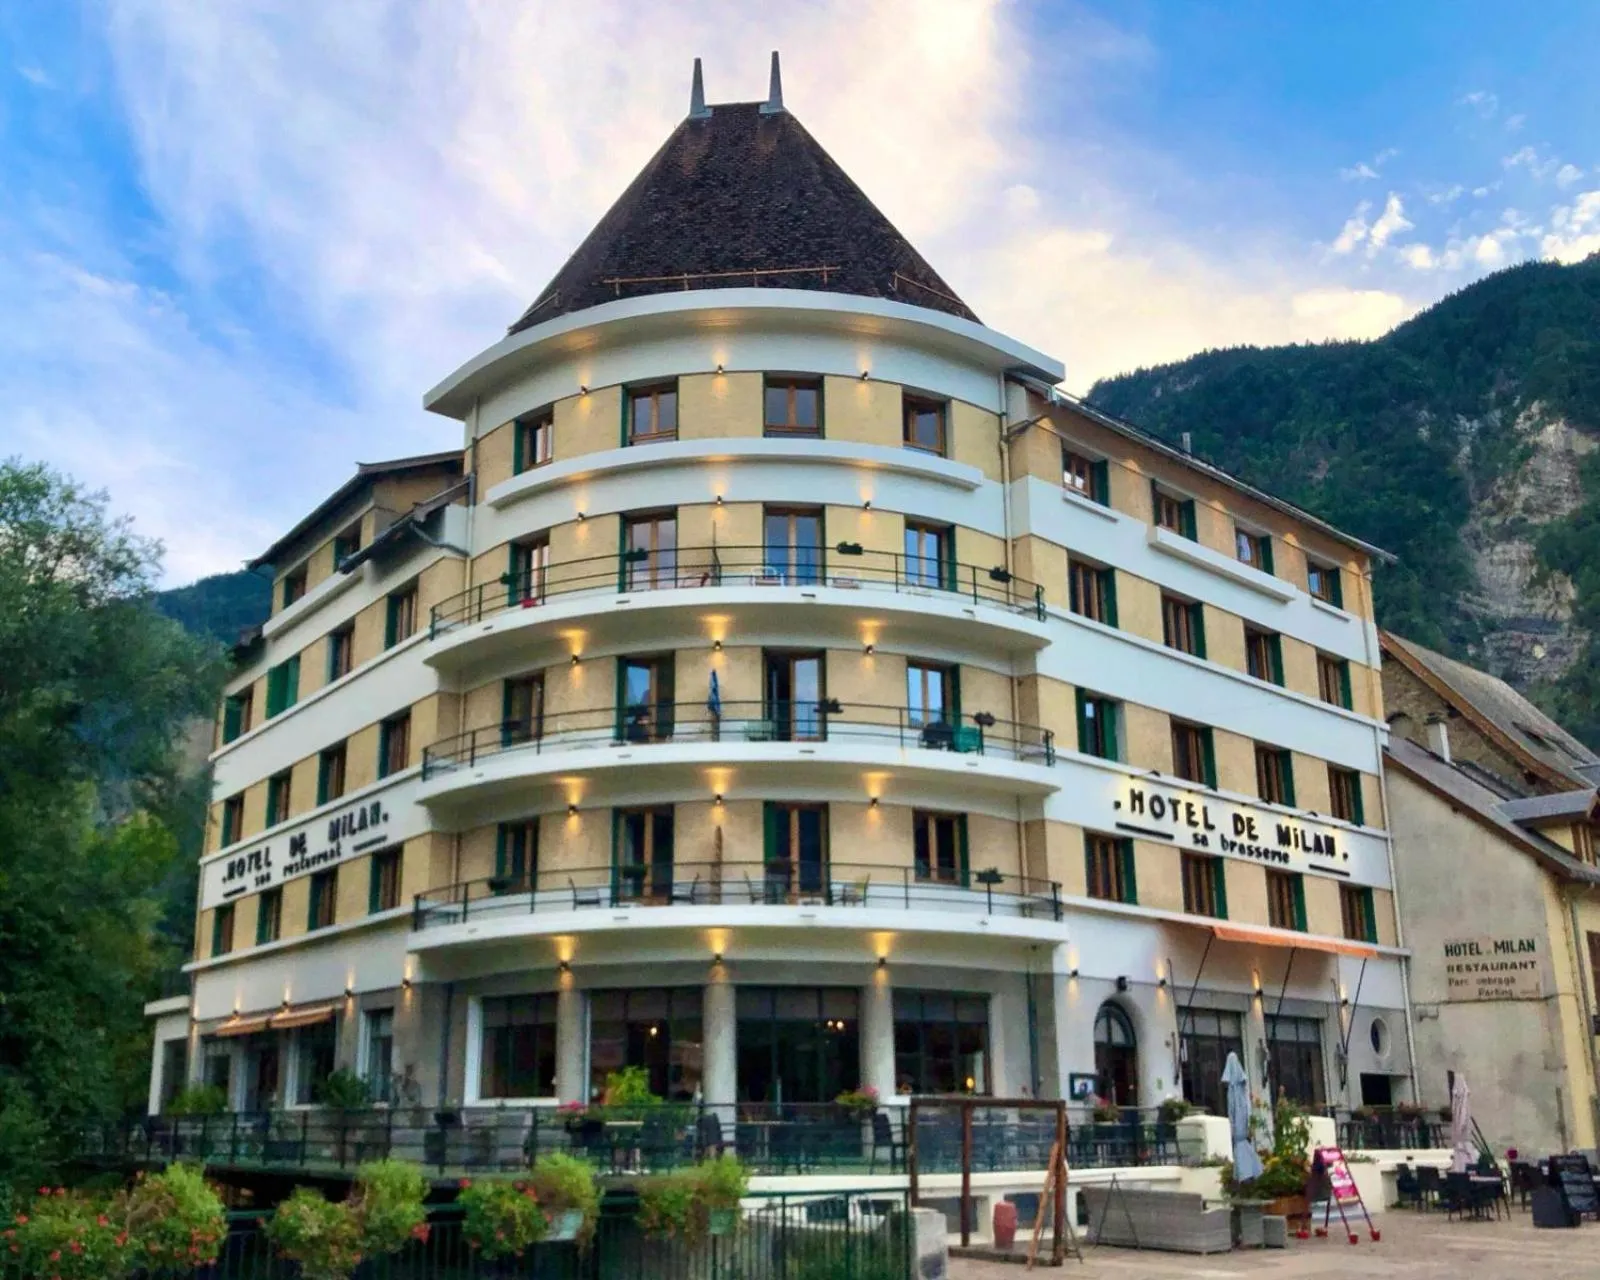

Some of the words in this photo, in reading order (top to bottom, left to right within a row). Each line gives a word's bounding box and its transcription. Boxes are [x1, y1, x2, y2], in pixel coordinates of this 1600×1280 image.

[1130, 788, 1216, 830] HOTEL
[1232, 812, 1259, 841] DE
[227, 846, 272, 881] HOTEL
[289, 832, 307, 857] DE
[283, 840, 342, 876] restaurant
[1192, 832, 1209, 847] sa
[1220, 834, 1290, 864] brasserie
[1444, 942, 1482, 957] HOTEL
[1494, 939, 1536, 955] MILAN
[1446, 960, 1537, 973] RESTAURANT
